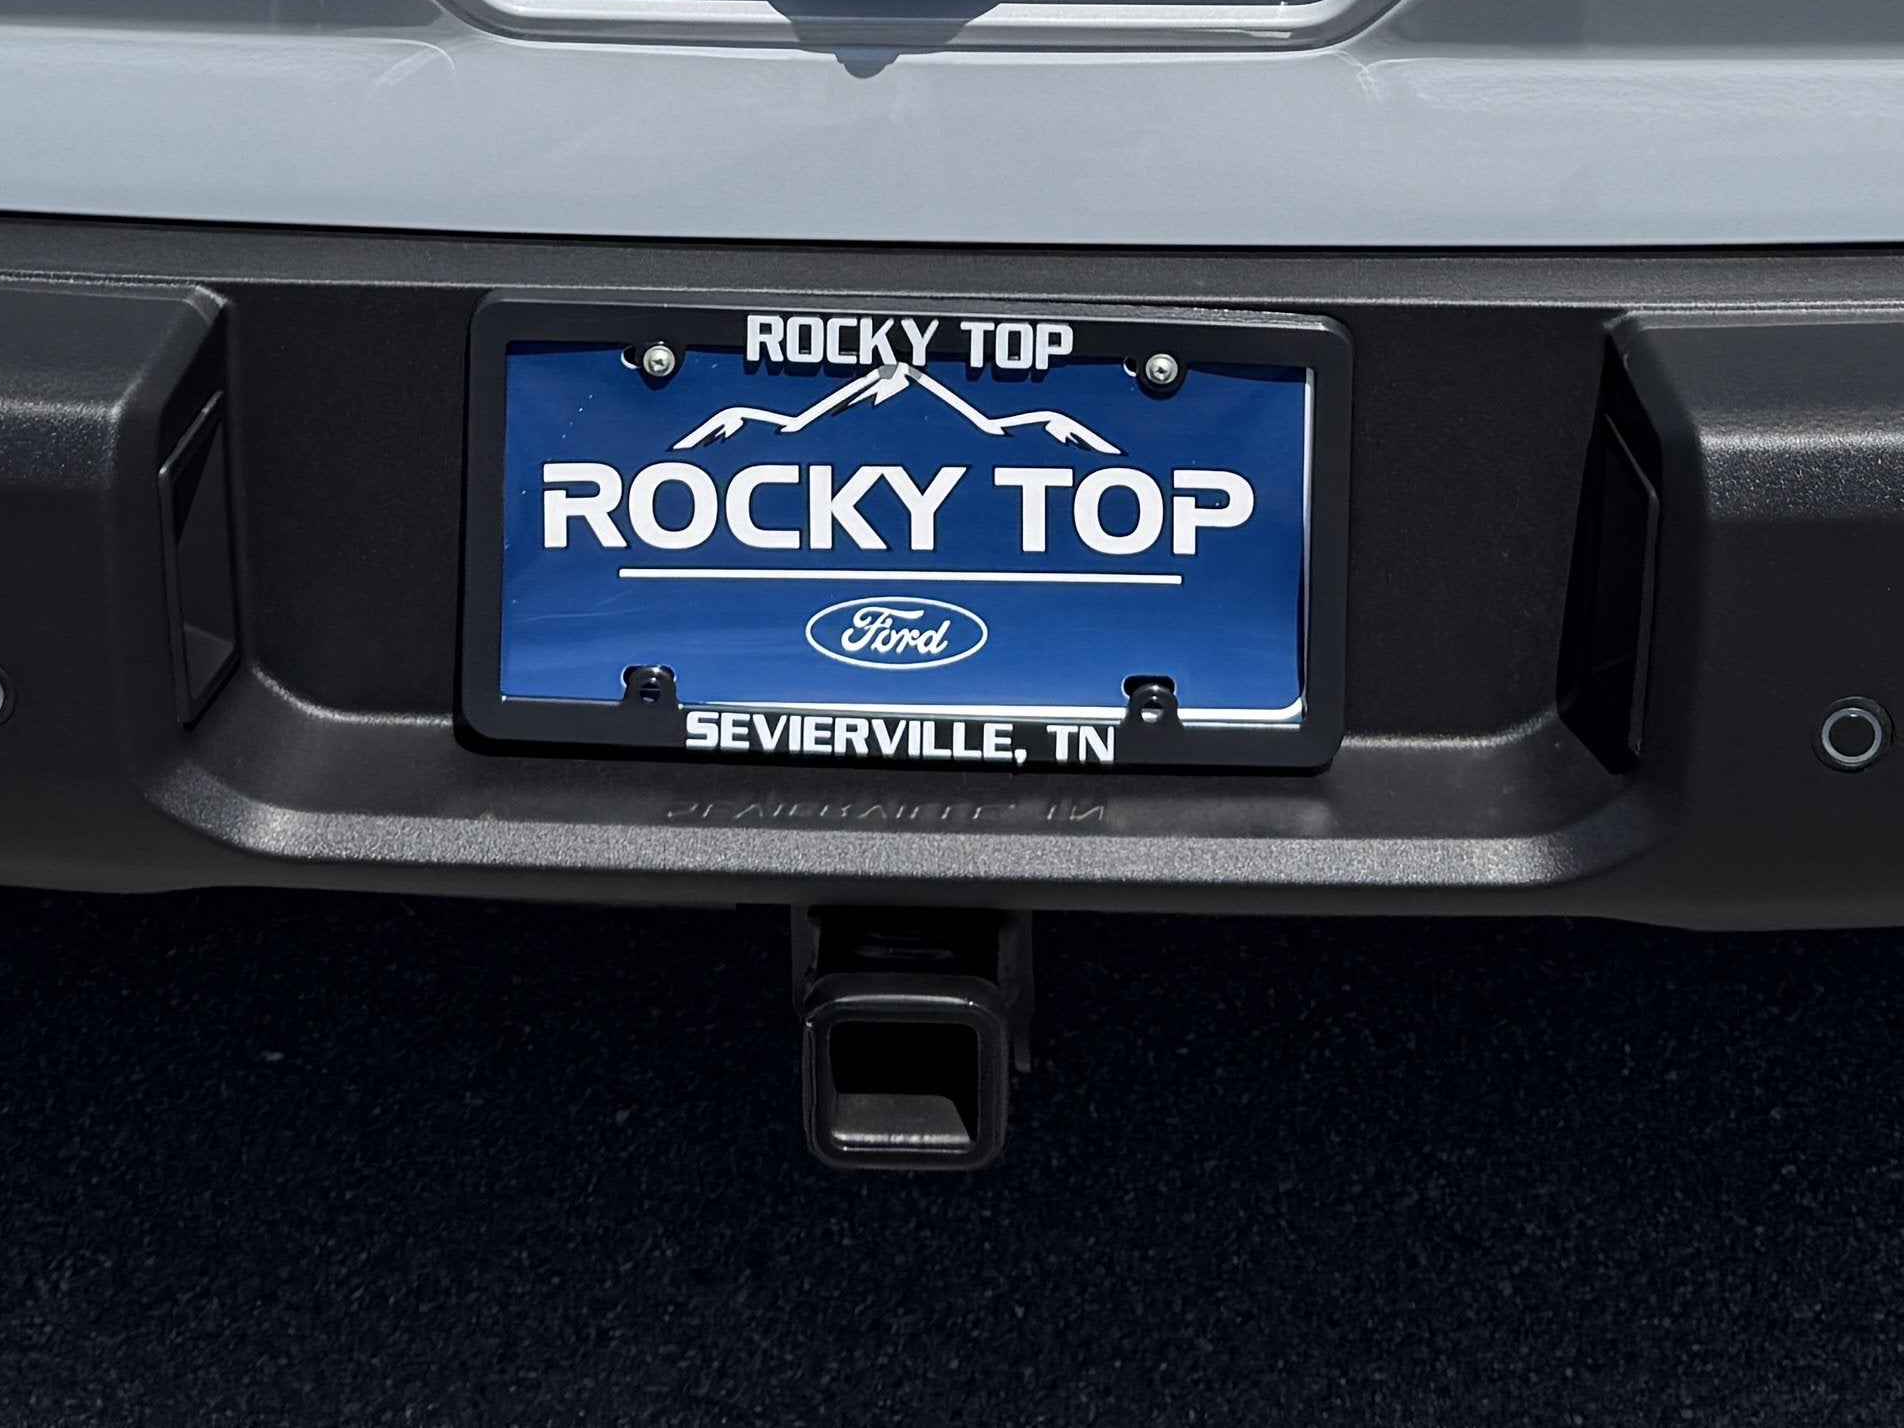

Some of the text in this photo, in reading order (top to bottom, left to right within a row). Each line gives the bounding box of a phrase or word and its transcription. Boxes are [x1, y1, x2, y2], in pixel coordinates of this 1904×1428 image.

[746, 315, 1074, 370] ROCKY TOP
[542, 461, 1255, 556] ROCKY TOP
[839, 605, 950, 658] Ford
[685, 711, 1114, 764] SEVIERVILLE, TN
